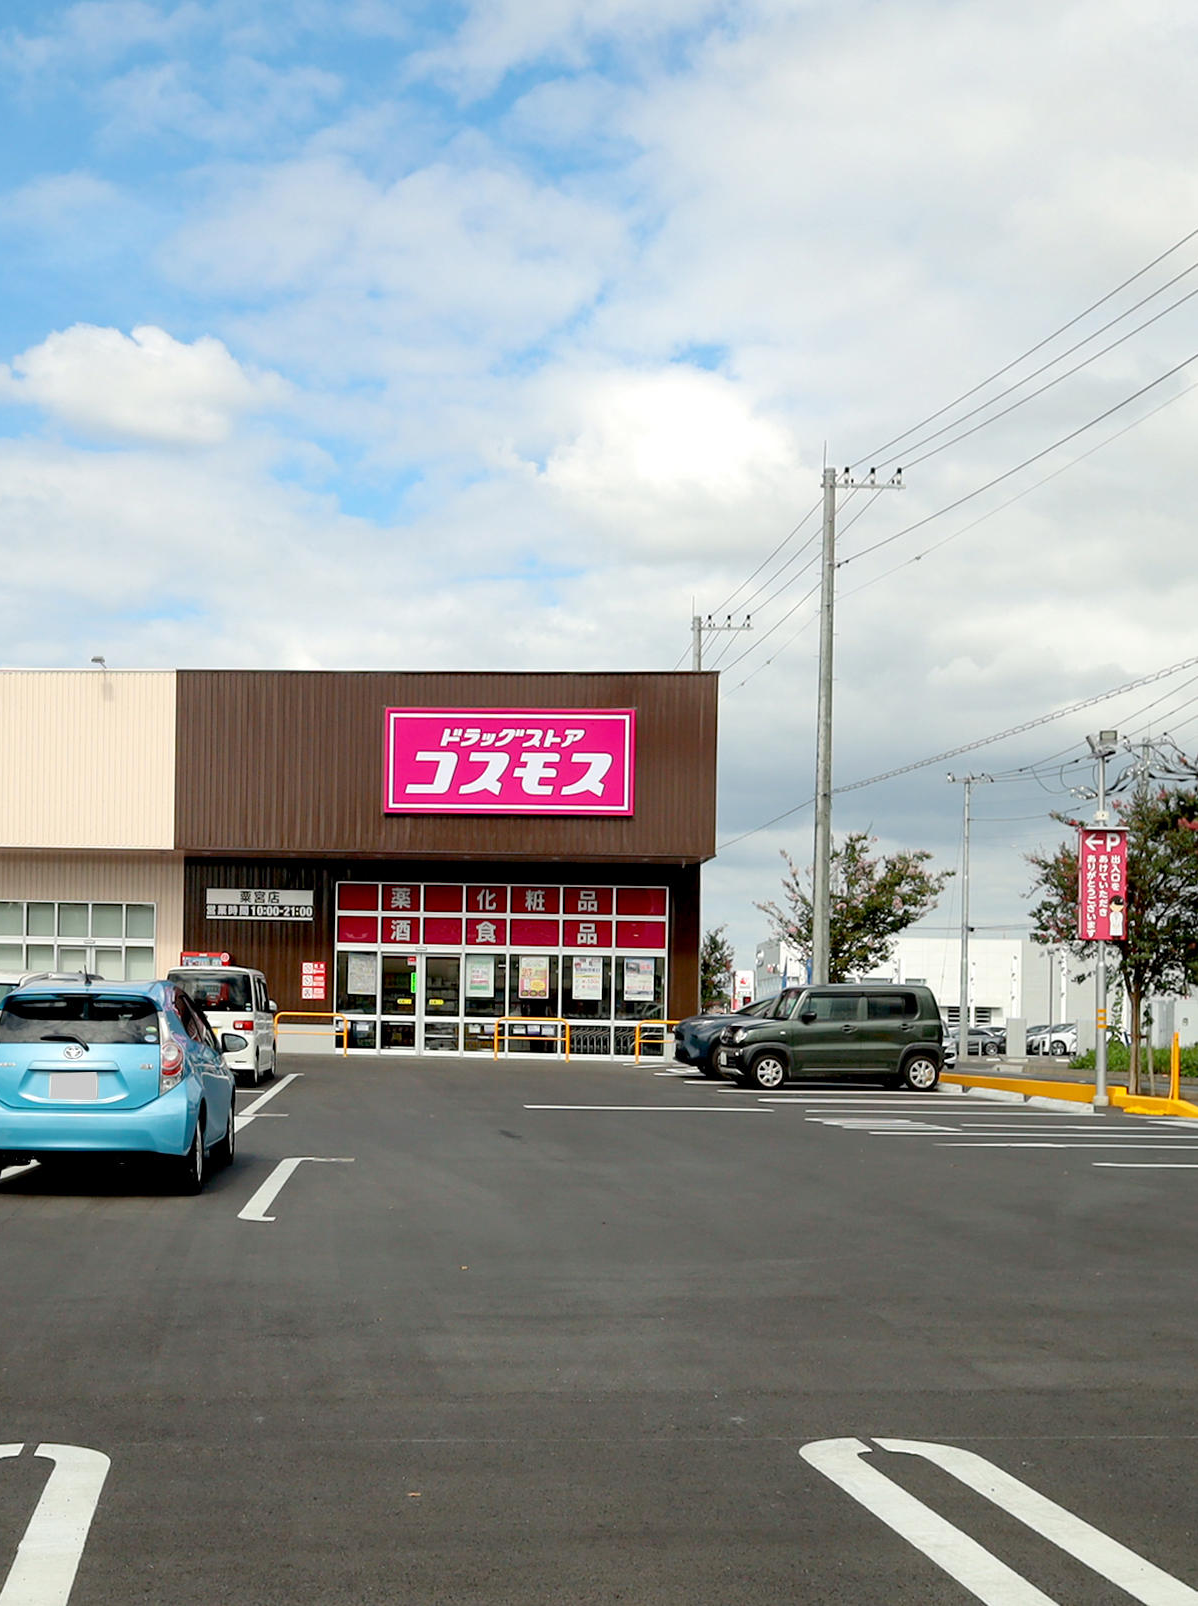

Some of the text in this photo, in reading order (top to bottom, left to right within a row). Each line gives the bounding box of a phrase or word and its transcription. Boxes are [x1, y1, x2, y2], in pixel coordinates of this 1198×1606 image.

[440, 728, 585, 748] ドラッグストア
[404, 751, 613, 797] コスモス
[1106, 832, 1121, 853] P
[1098, 854, 1109, 917] あけていただき
[1110, 854, 1122, 892] 出入口を
[391, 887, 598, 912] 薬 化粧品
[1086, 854, 1097, 938] ありがとうございます
[390, 919, 598, 945] 酒 食品
